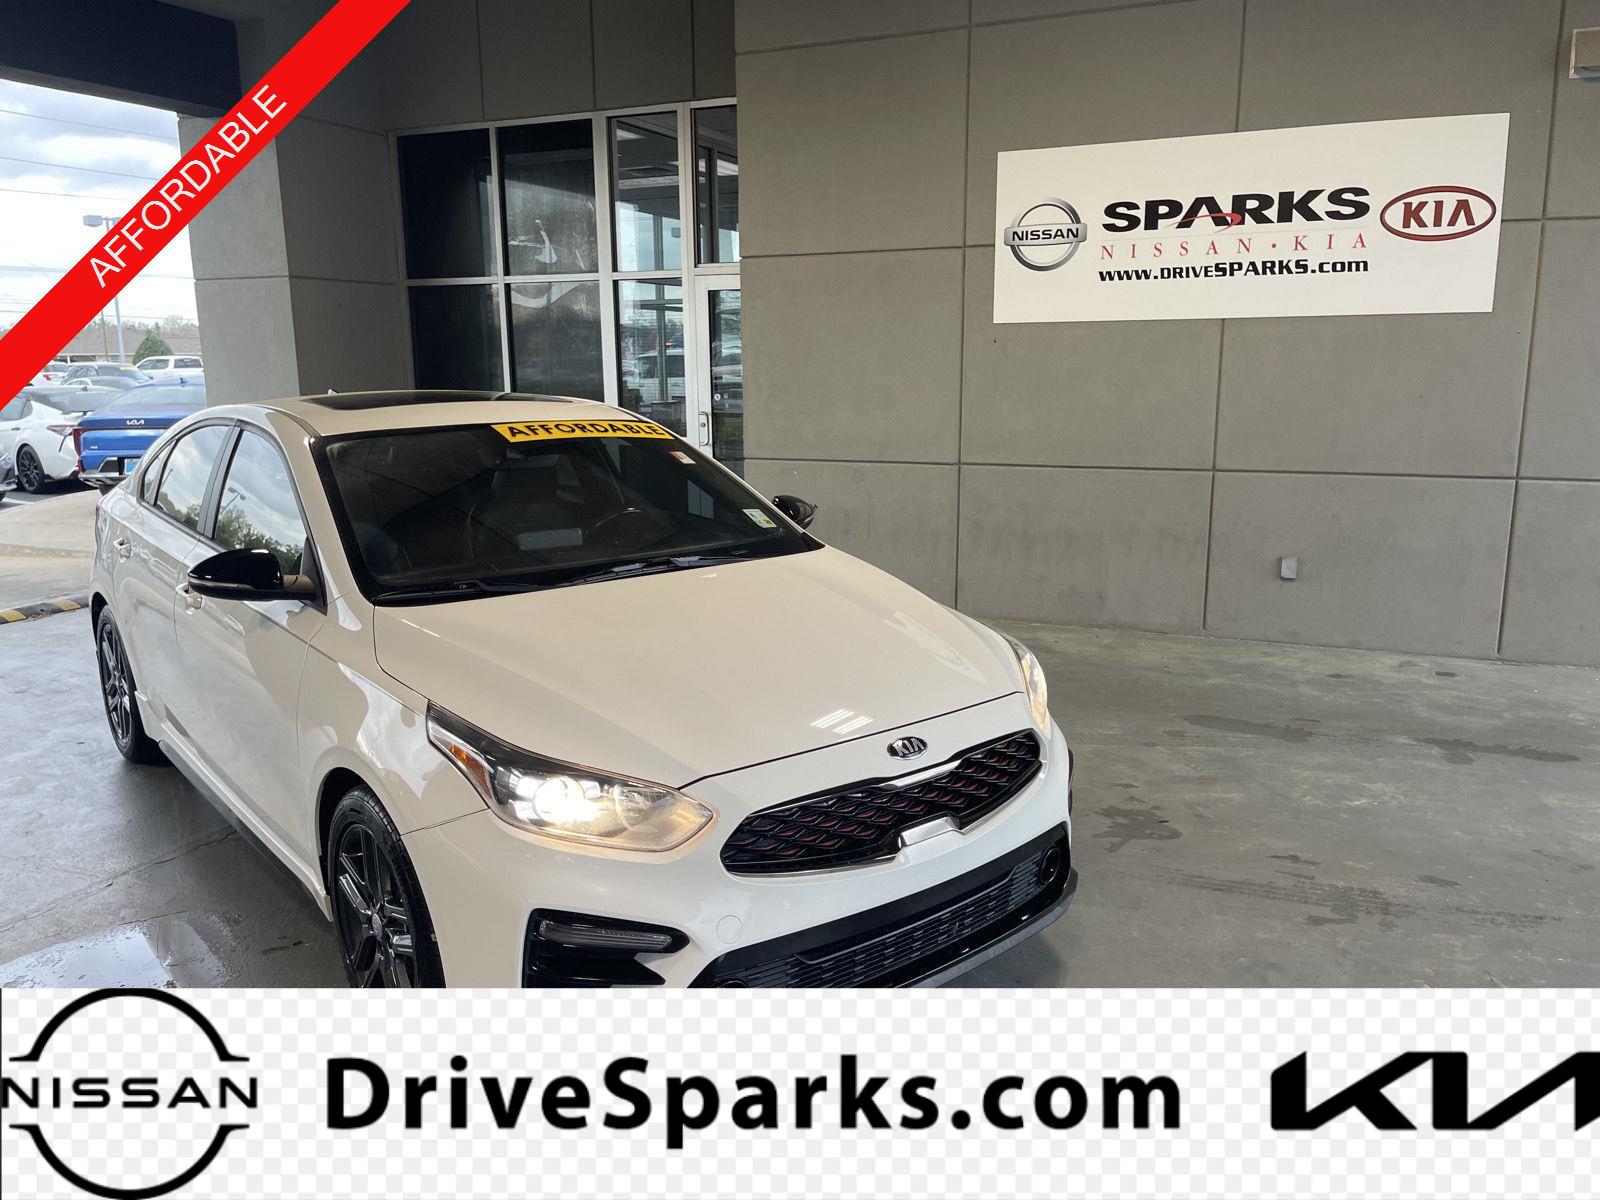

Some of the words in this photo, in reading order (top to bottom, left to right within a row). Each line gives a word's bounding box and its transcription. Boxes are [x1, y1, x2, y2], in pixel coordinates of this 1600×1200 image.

[1101, 187, 1371, 233] SPARKS
[1402, 199, 1476, 229] KIA
[1012, 228, 1079, 242] NISSAN
[1100, 238, 1252, 260] NISSAN
[1293, 232, 1367, 252] KIA
[507, 422, 665, 438] AFFORDABLE
[891, 738, 925, 757] KIA
